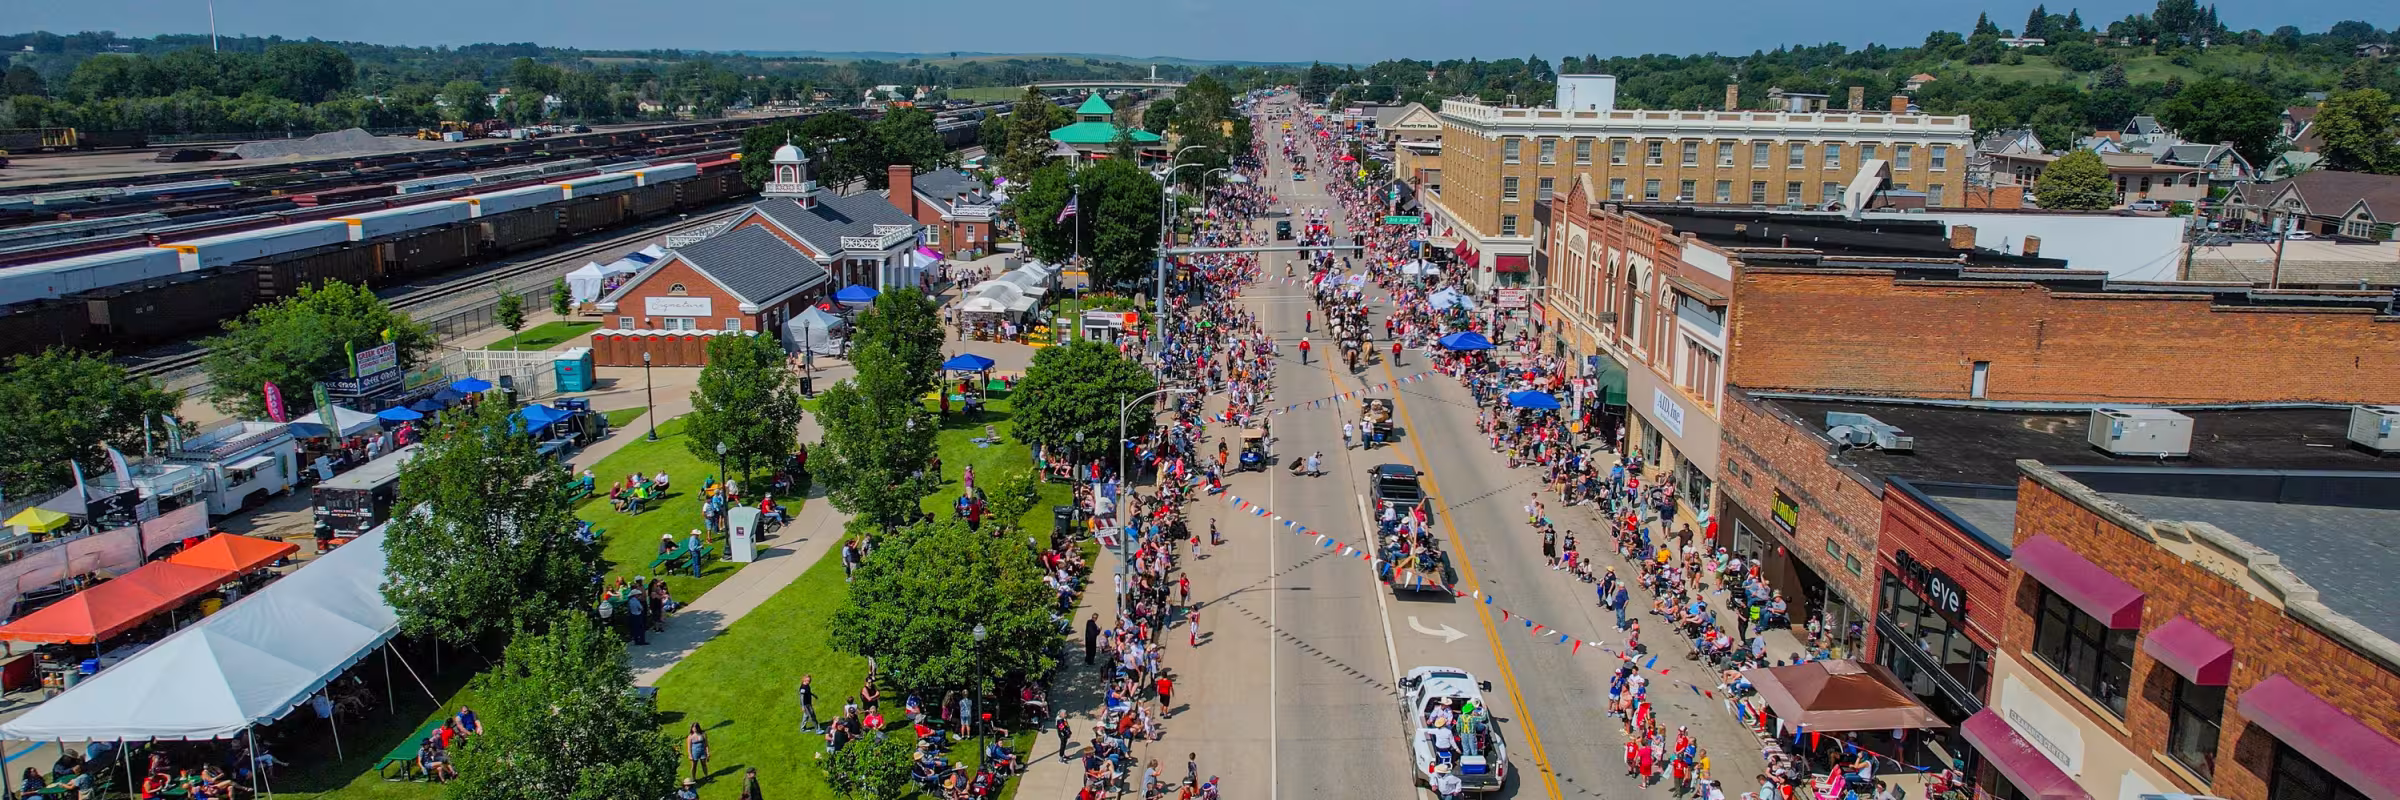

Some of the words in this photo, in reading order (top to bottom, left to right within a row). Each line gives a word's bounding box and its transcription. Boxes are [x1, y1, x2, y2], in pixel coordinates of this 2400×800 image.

[651, 298, 705, 312] Signature
[363, 374, 380, 386] GREEK
[1895, 548, 1931, 594] every
[1931, 577, 1960, 612] eye
[2010, 711, 2044, 745] CLEARANCE
[2044, 740, 2069, 766] CENTER
